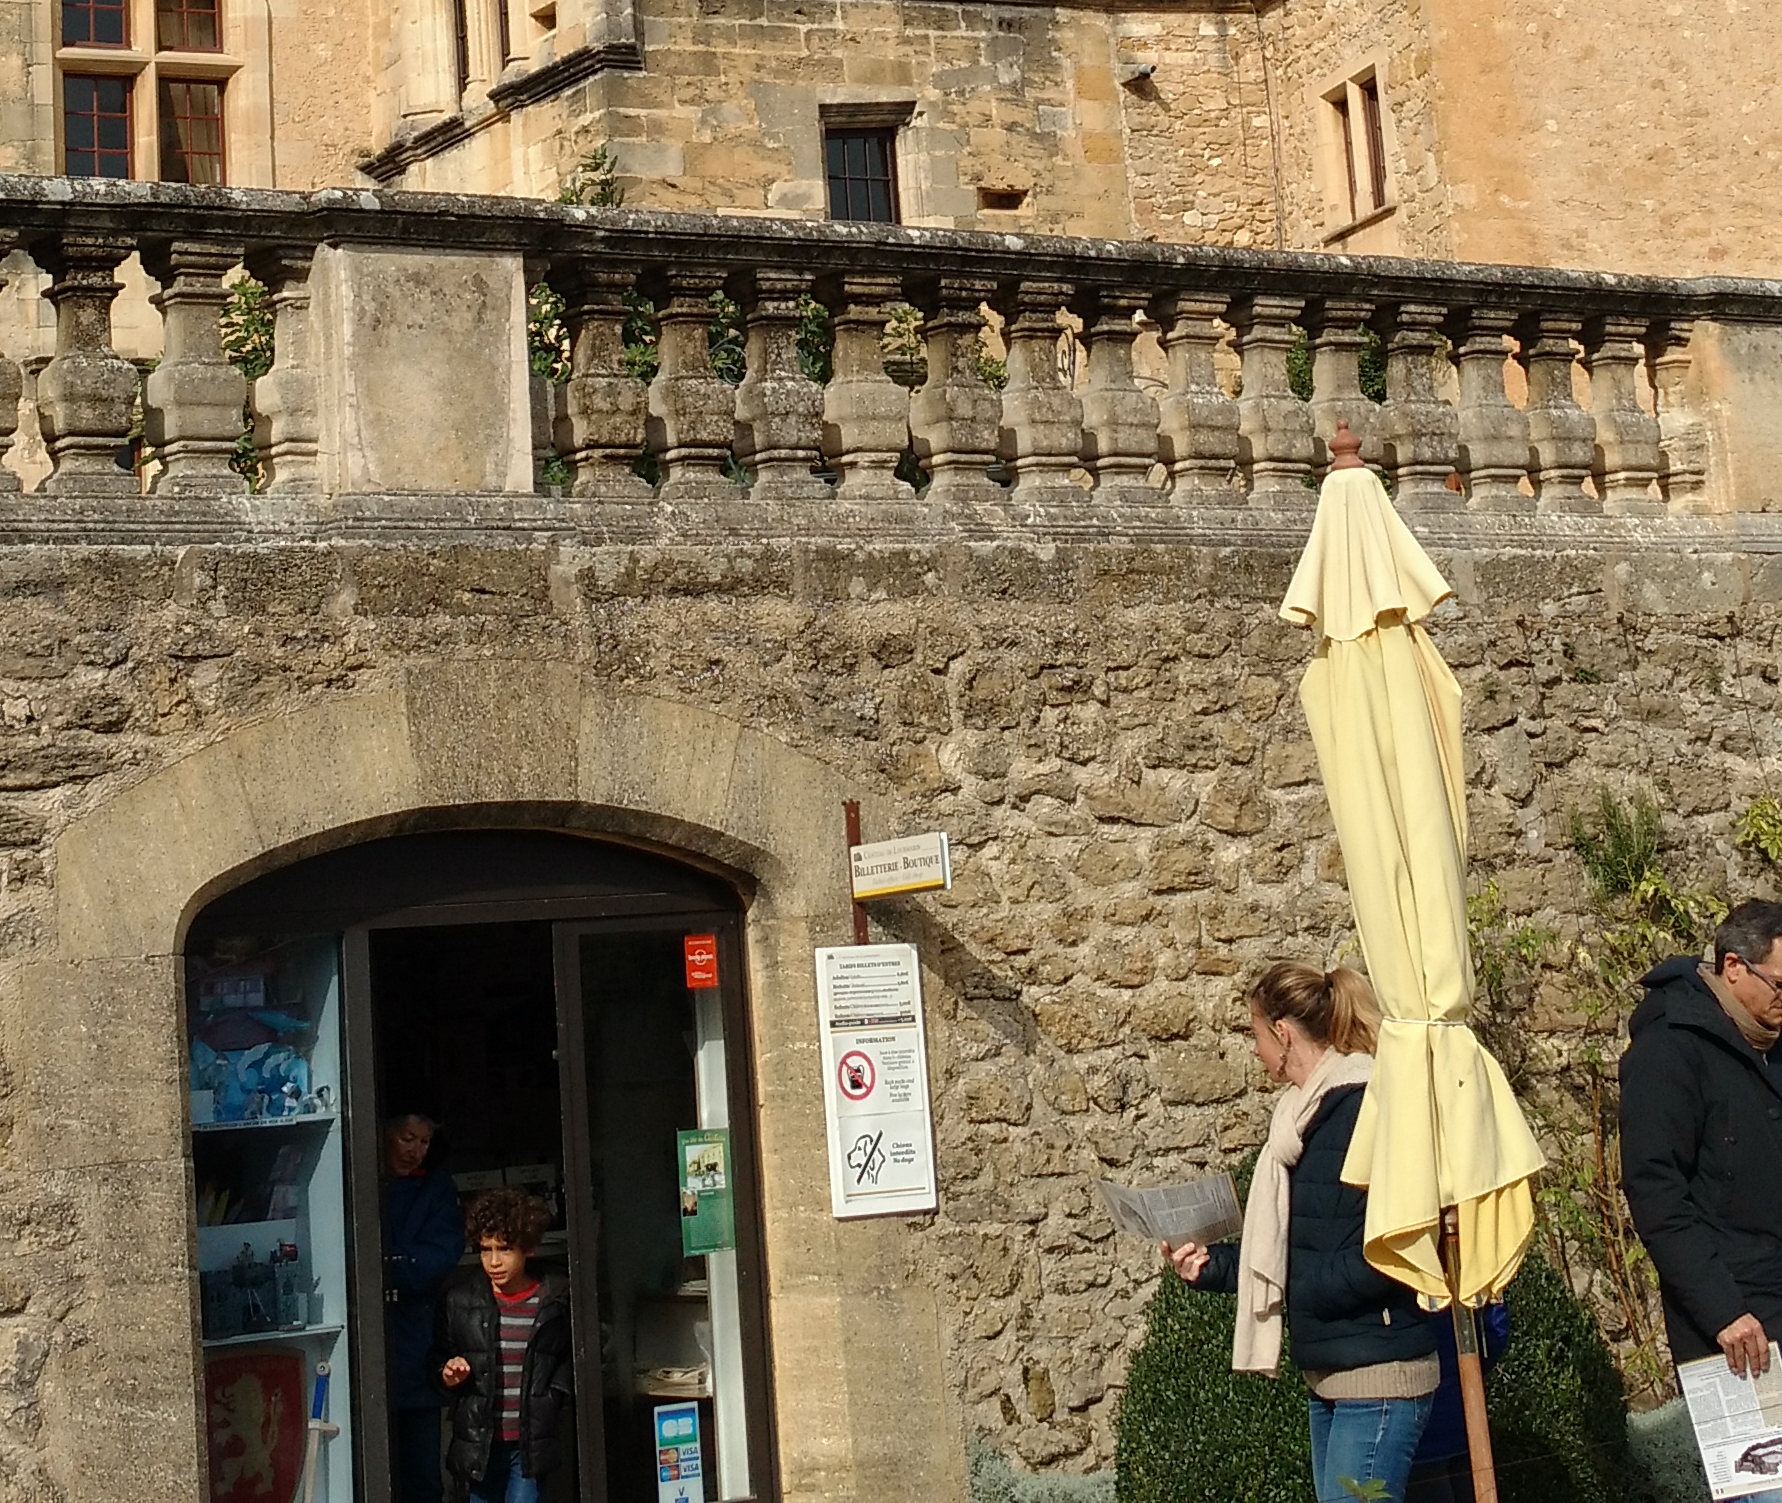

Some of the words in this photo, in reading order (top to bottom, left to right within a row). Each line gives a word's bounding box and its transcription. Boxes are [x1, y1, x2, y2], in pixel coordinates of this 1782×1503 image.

[854, 861, 899, 878] BILLETTERIE
[902, 854, 940, 870] BOUTIQUE
[855, 1036, 896, 1044] INFORMATION
[890, 1149, 916, 1157] interdits
[681, 1446, 699, 1456] VISA
[682, 1463, 700, 1473] VISA
